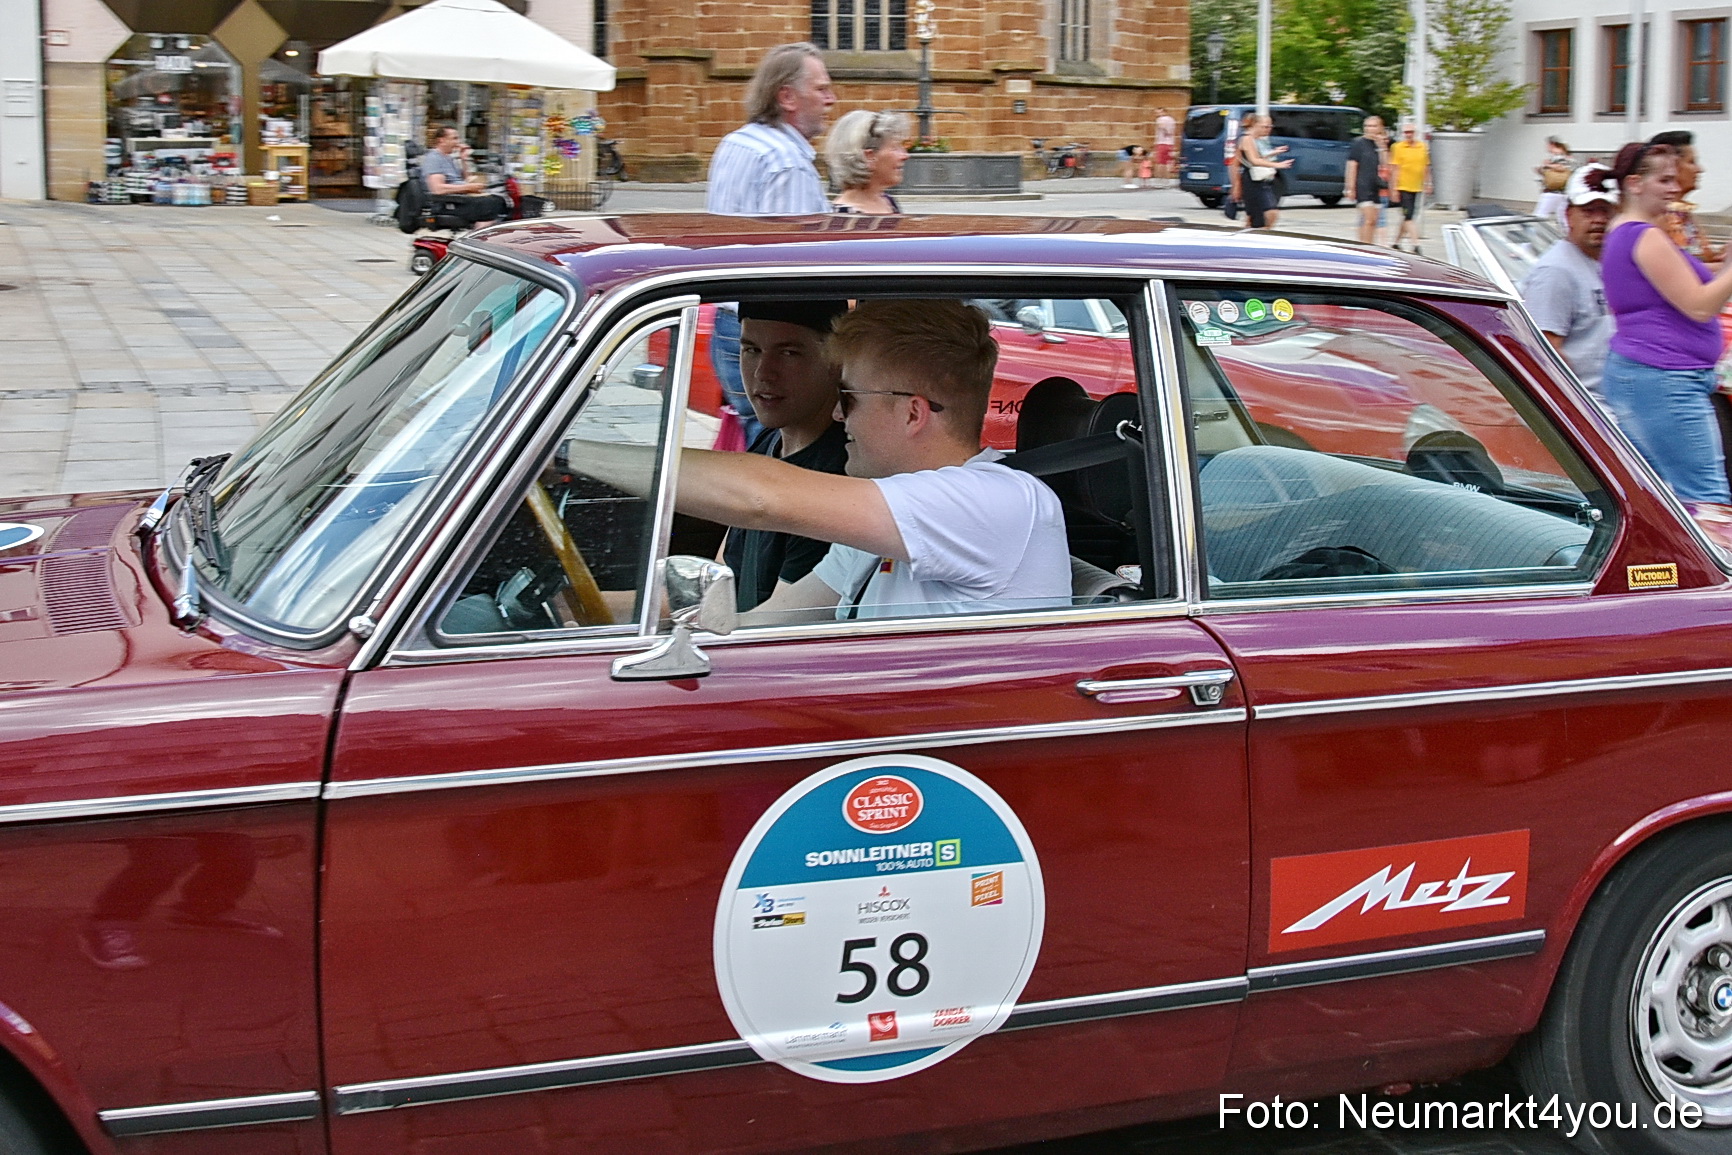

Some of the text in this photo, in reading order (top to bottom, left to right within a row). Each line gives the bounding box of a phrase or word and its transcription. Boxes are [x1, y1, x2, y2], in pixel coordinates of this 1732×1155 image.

[1633, 571, 1671, 581] VICTORIA
[853, 793, 914, 808] CLASSIC
[857, 806, 909, 821] SPRINT
[805, 842, 933, 867] SONNLEITNER
[906, 858, 934, 869] AUTO
[1281, 857, 1516, 934] Metz
[858, 898, 910, 914] HISCOX
[835, 932, 930, 1004] 58
